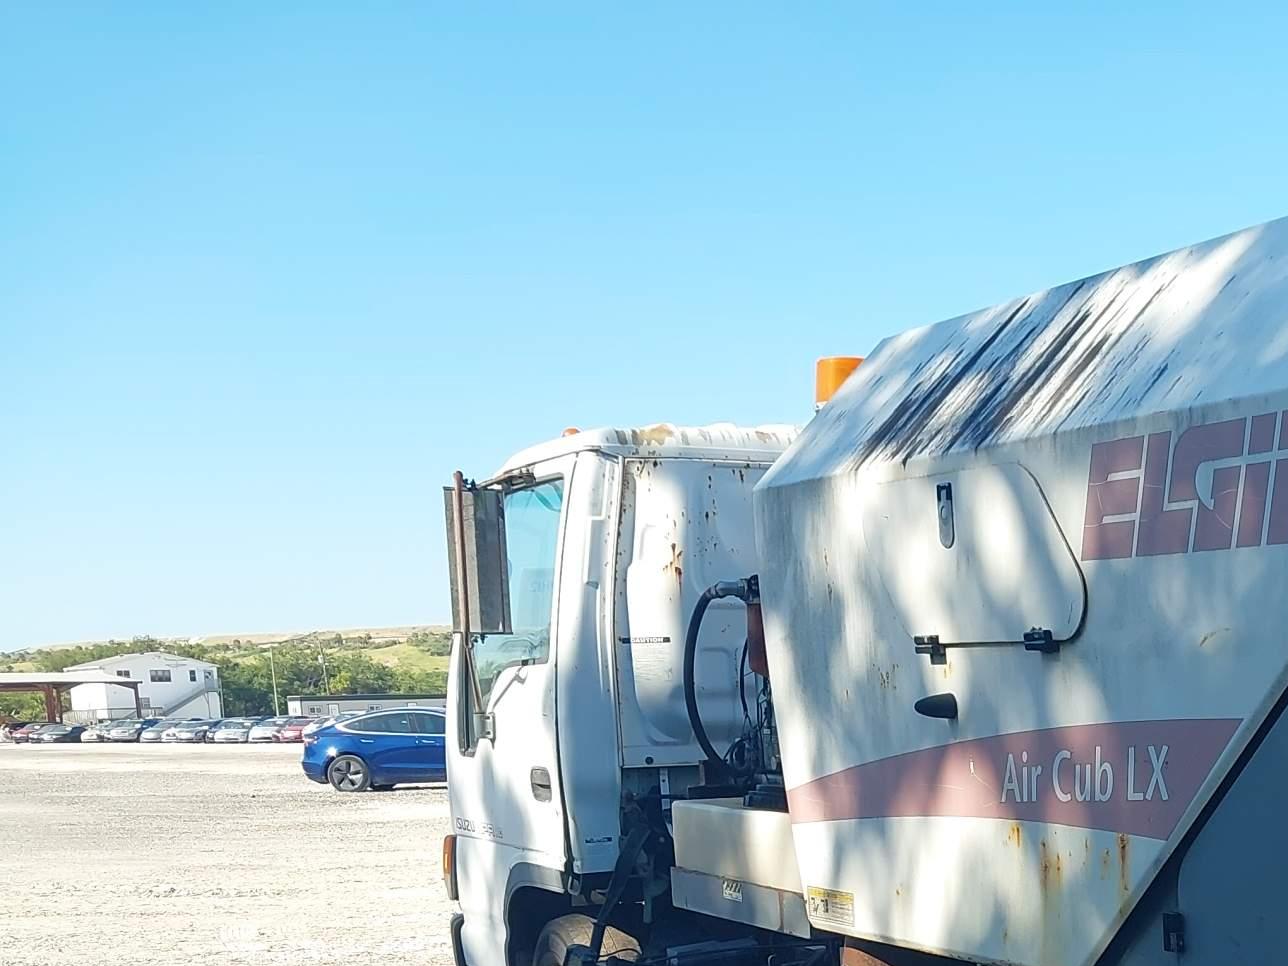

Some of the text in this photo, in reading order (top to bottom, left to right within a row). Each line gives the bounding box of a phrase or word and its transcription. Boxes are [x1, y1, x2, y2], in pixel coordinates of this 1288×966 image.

[1000, 745, 1169, 803] Air Cub LX
